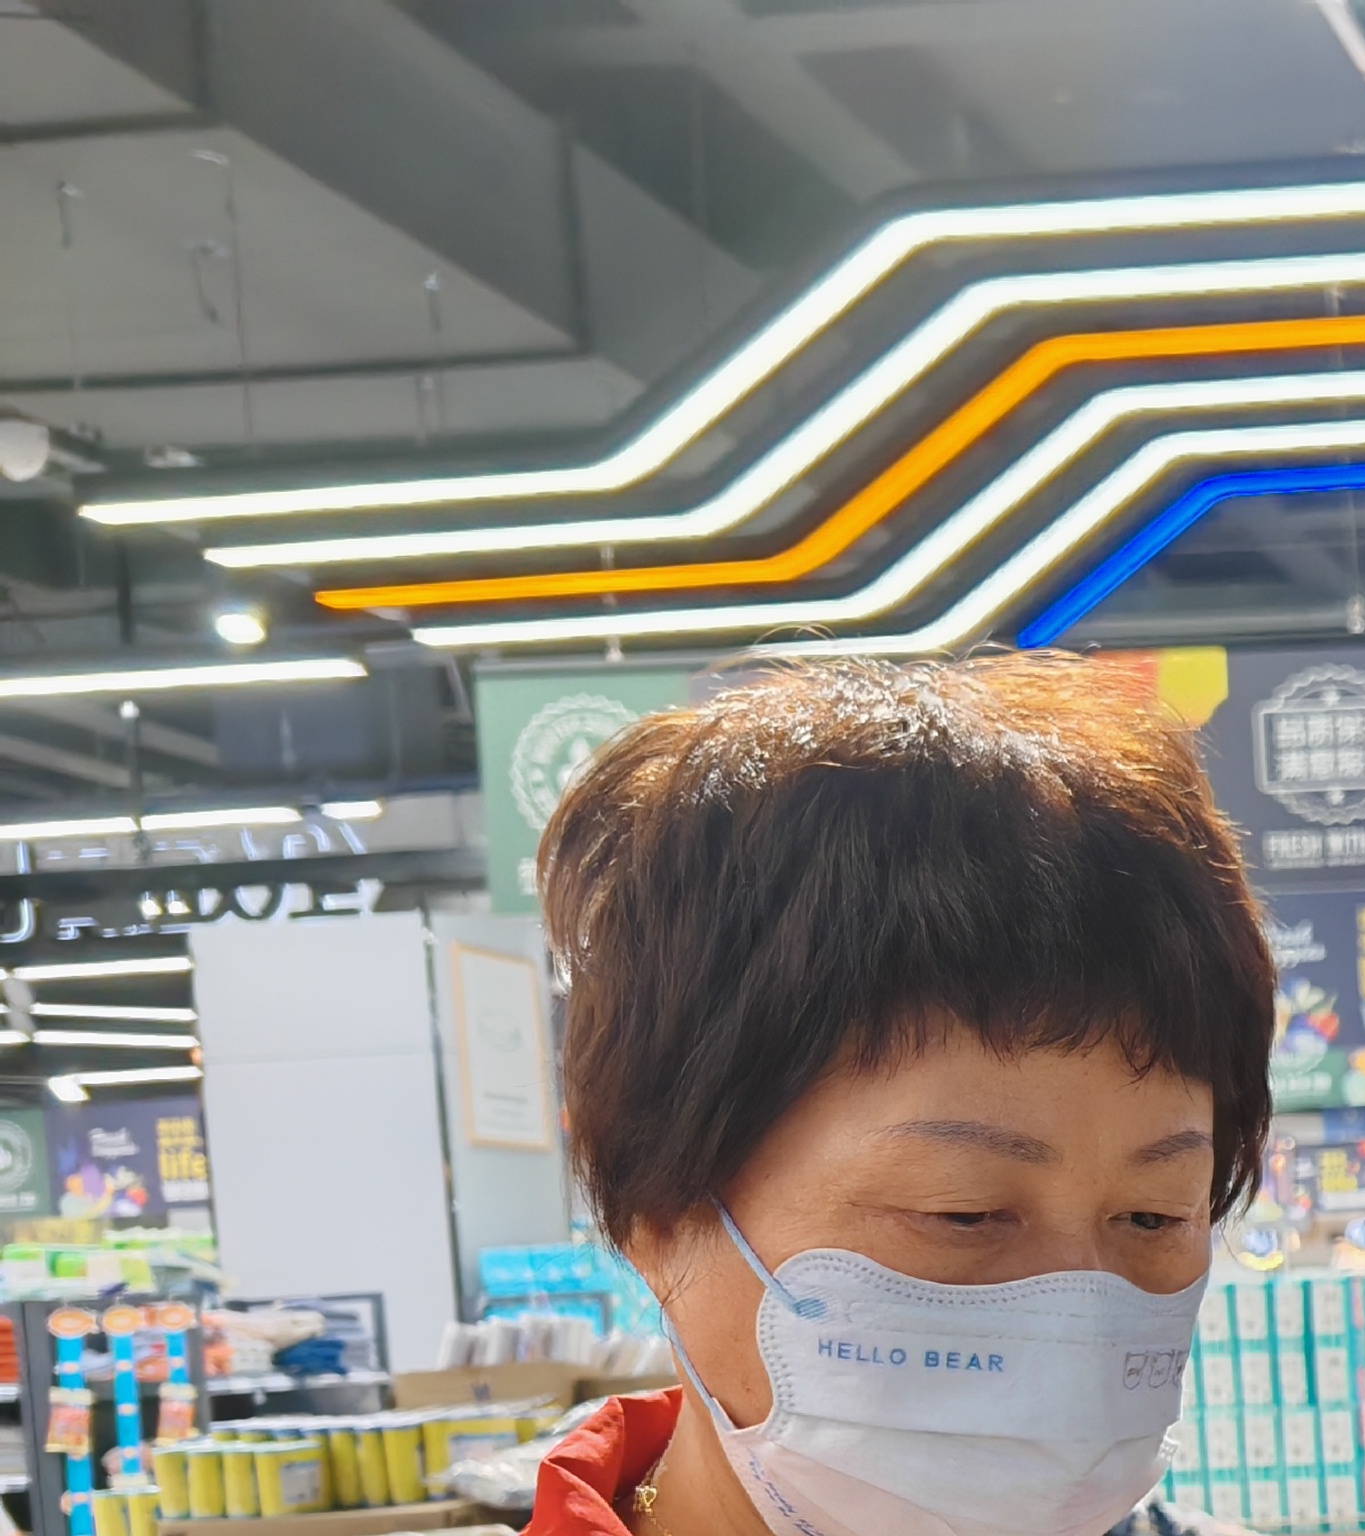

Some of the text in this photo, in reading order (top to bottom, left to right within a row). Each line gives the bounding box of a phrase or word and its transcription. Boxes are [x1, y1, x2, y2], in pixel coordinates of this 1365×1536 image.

[1263, 830, 1324, 863] FRESH
[817, 1338, 1006, 1374] HELLO BEAR
